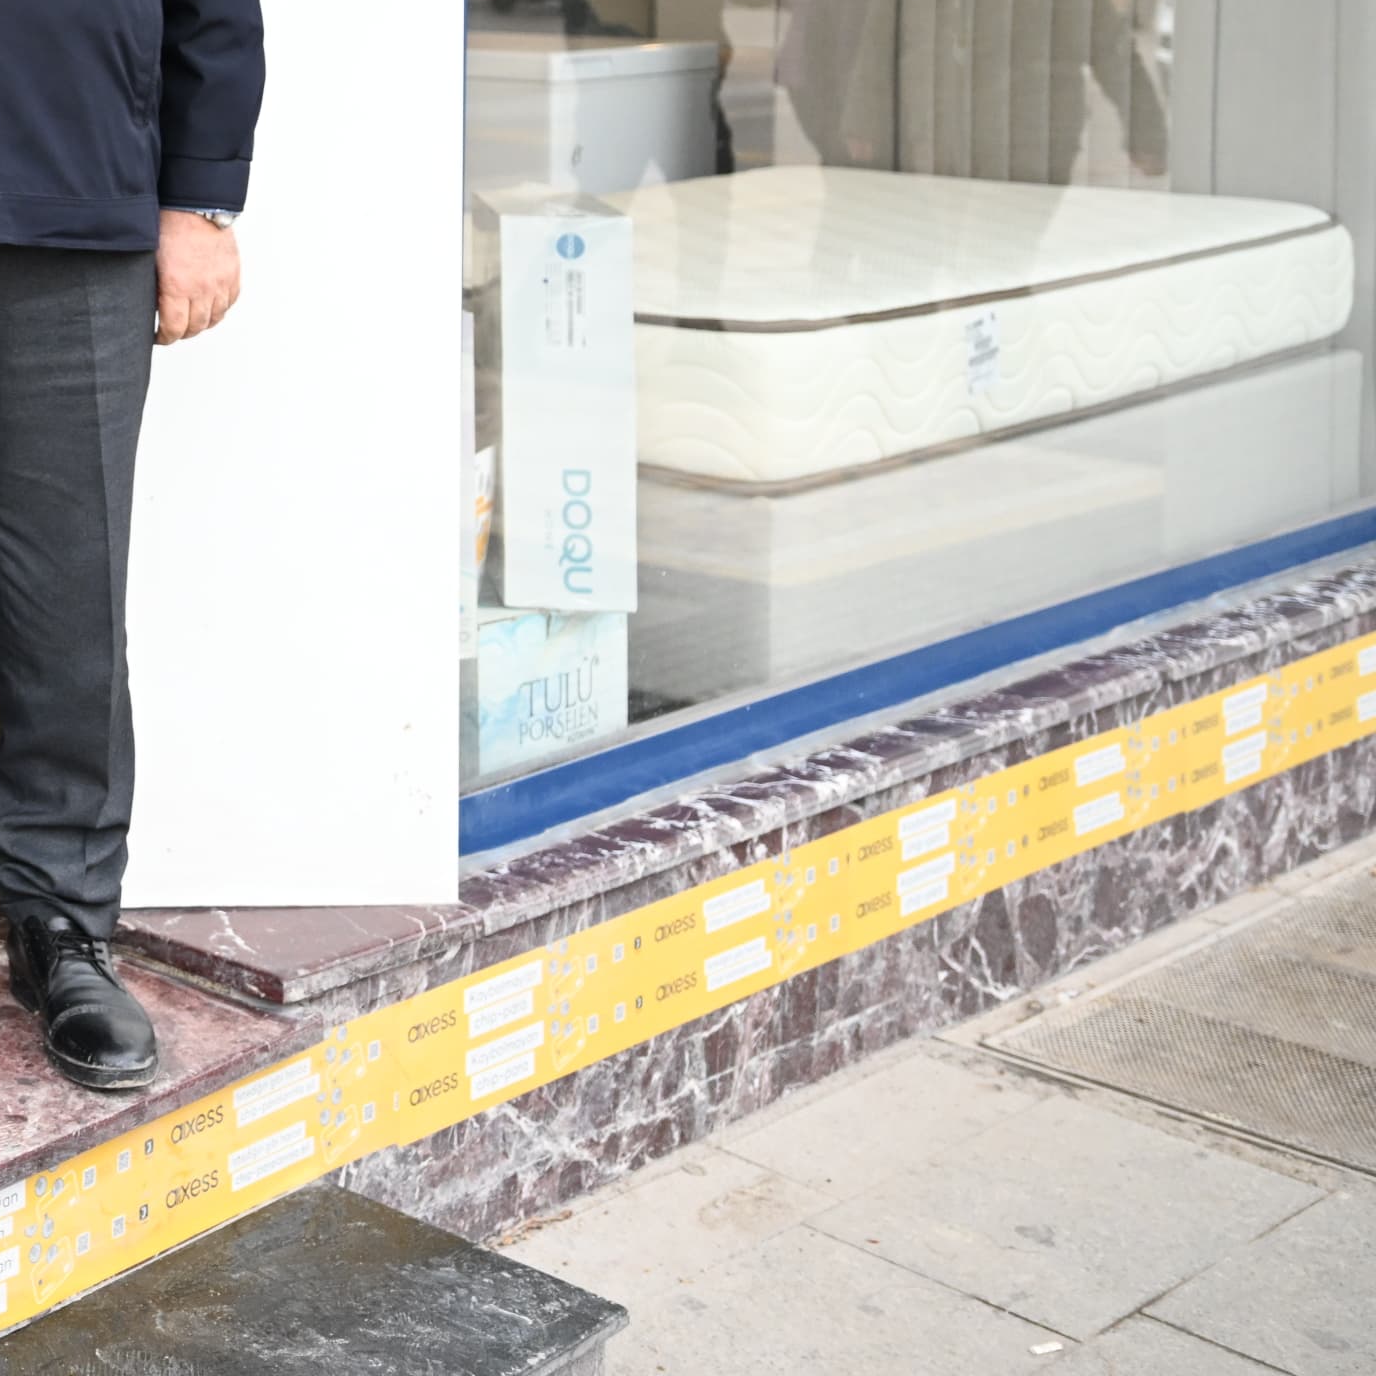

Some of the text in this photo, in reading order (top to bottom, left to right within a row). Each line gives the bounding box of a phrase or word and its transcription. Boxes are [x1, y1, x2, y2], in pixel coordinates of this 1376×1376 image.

[559, 469, 594, 595] DOQU
[653, 911, 697, 943] axess
[654, 970, 698, 1003] axess
[407, 1009, 458, 1044] axess
[408, 1071, 459, 1108] axess
[169, 1103, 225, 1146] axess
[165, 1168, 220, 1211] axess
